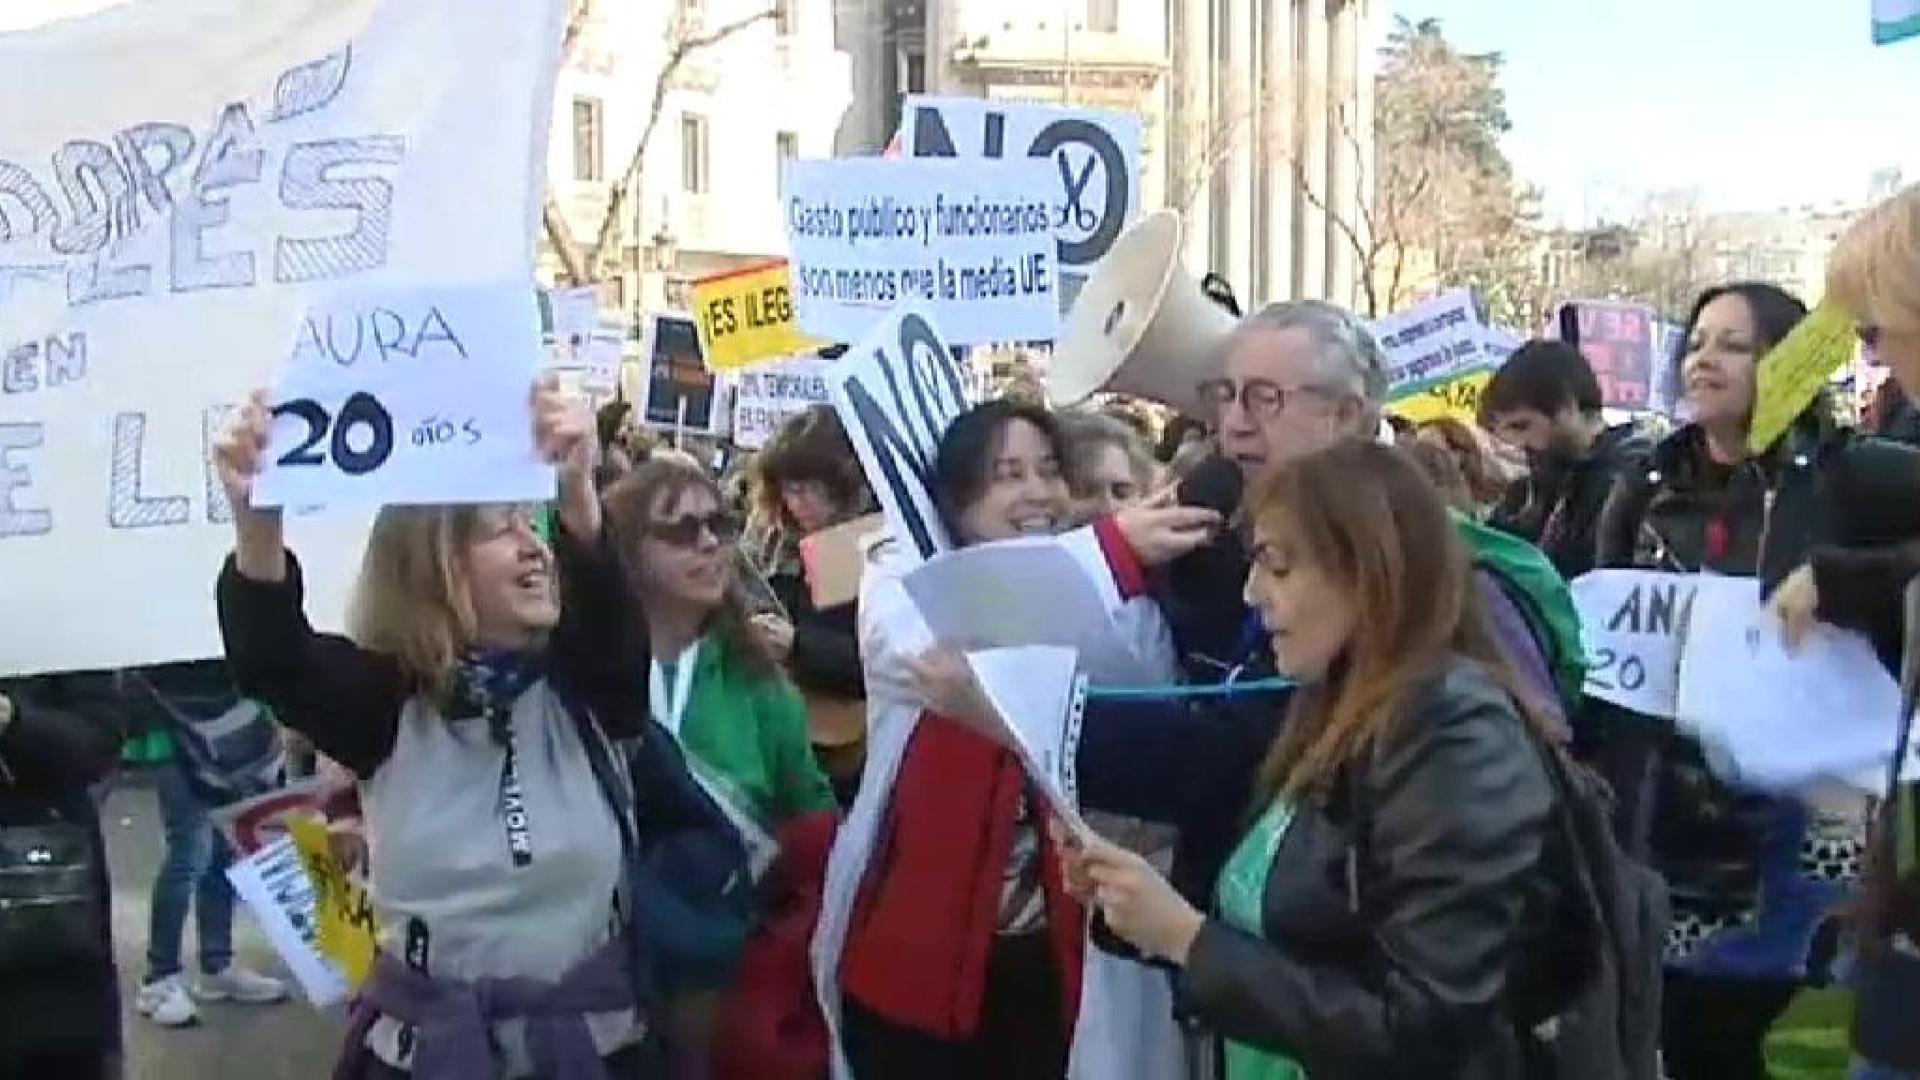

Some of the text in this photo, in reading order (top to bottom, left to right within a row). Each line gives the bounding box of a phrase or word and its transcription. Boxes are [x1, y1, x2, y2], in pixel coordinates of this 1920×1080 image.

[790, 192, 1048, 247] Gasto público y funcionarios
[836, 268, 895, 301] menos
[938, 257, 956, 300] la
[960, 254, 1017, 300] media
[3, 331, 87, 395] EN
[268, 390, 395, 477] 20
[1585, 647, 1646, 691] 20
